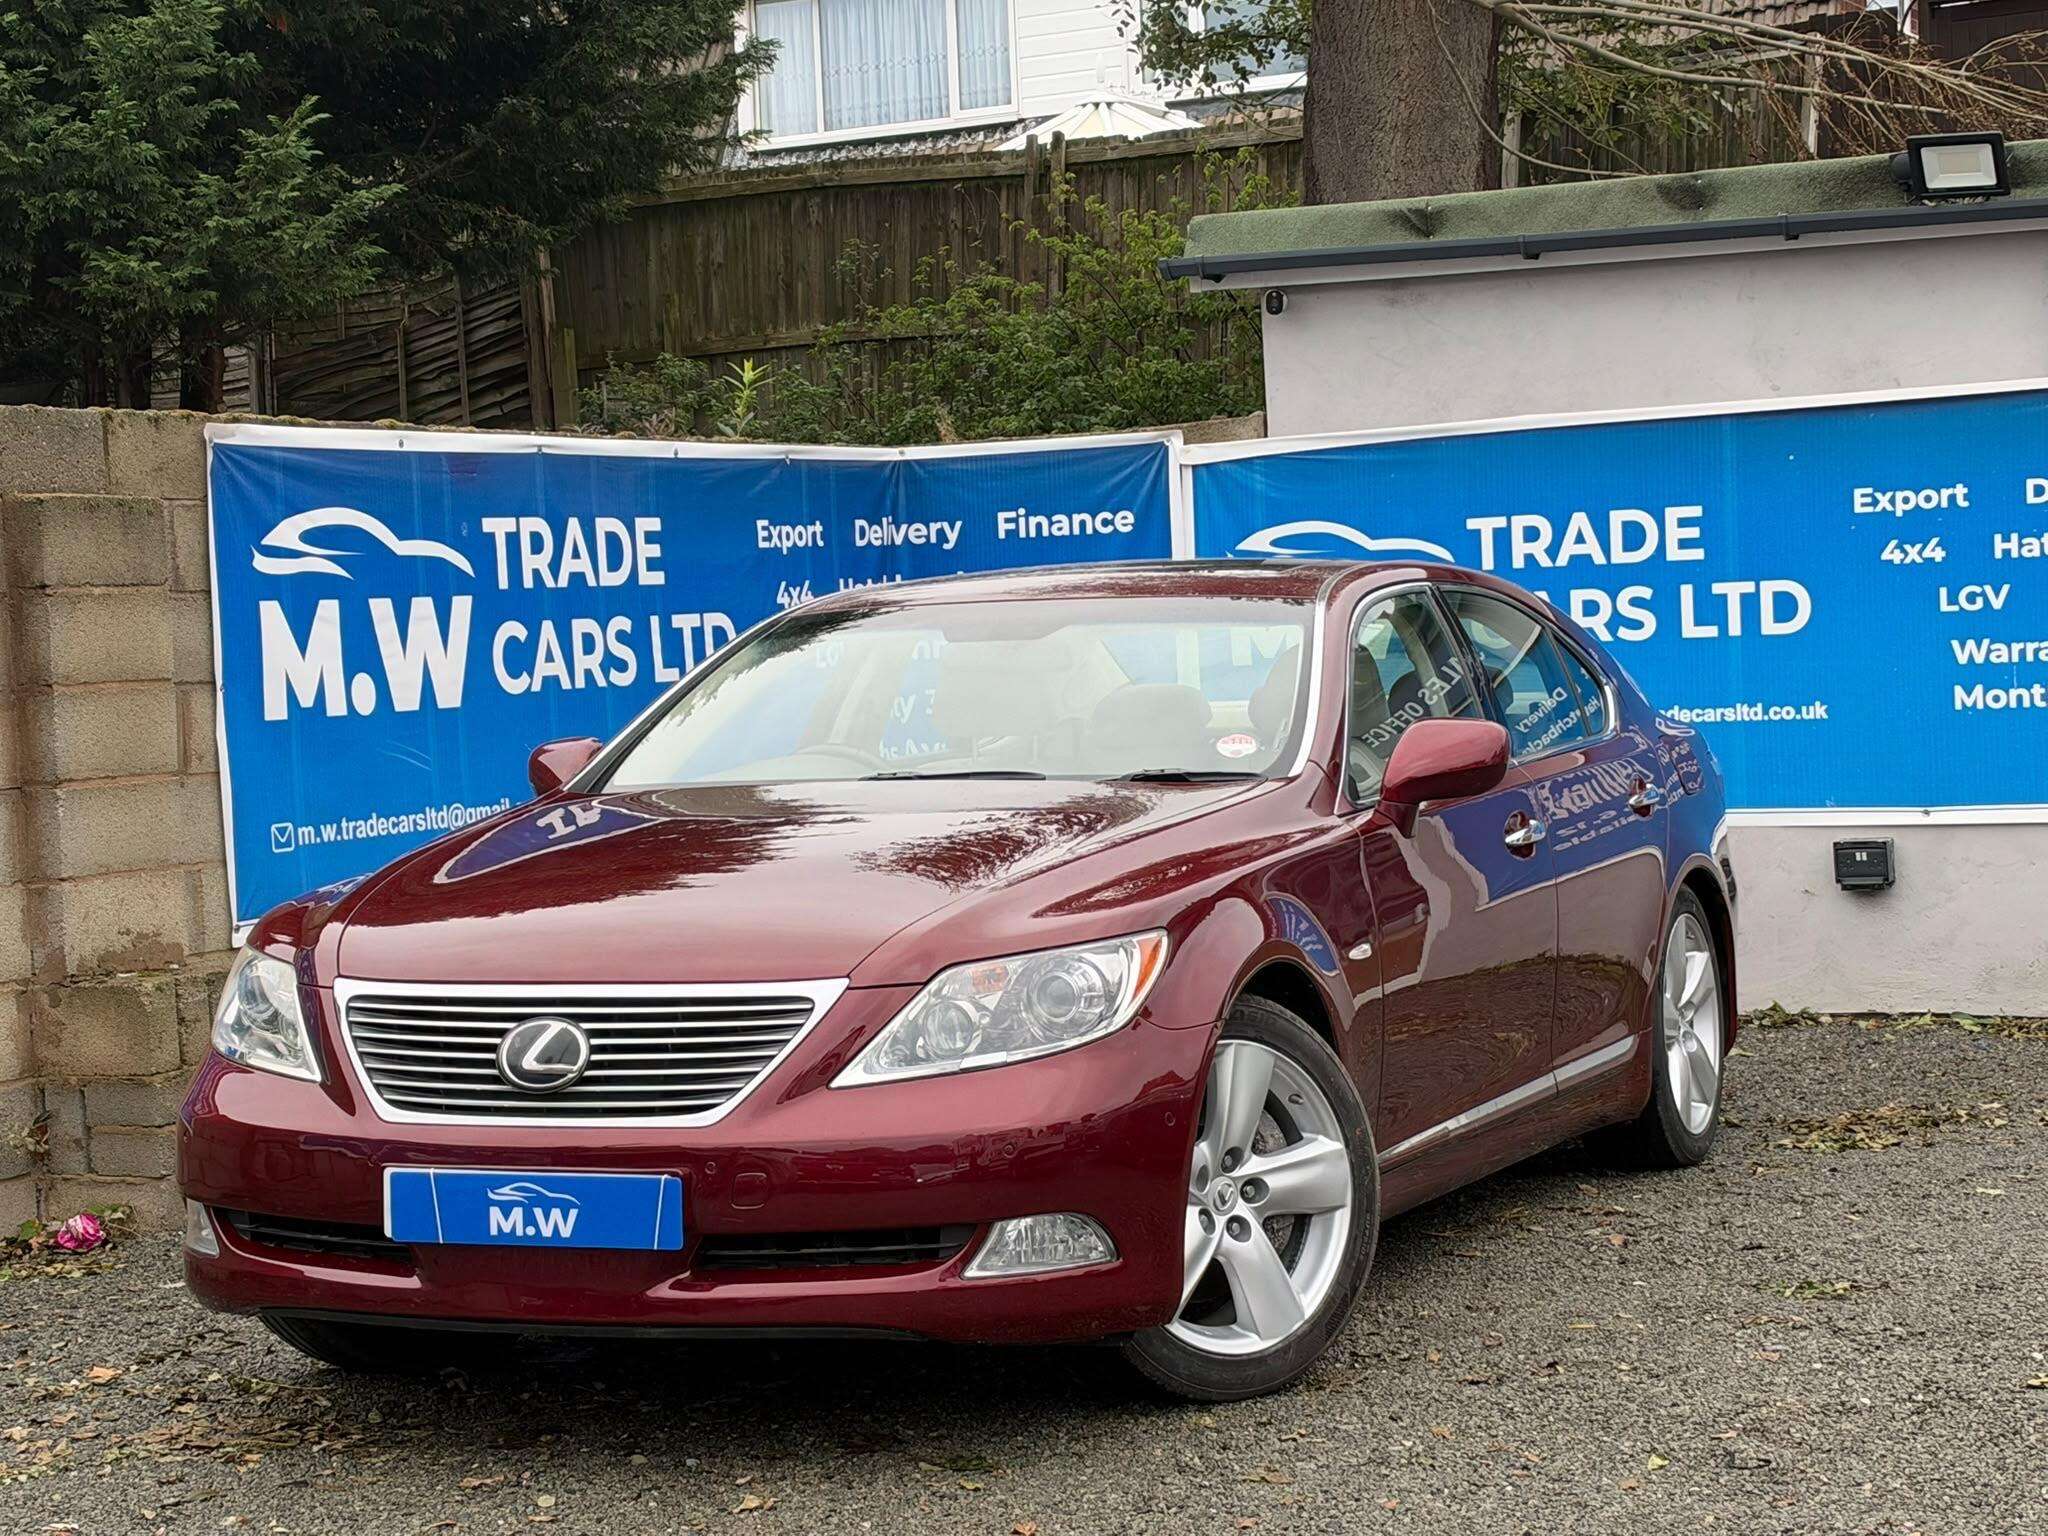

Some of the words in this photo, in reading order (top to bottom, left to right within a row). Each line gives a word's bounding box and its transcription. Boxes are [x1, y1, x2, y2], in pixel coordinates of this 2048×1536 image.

[1853, 483, 1970, 517] Export
[481, 516, 666, 590] TRADE
[756, 518, 824, 554] Export
[853, 515, 962, 550] Delivery
[996, 507, 1135, 540] Finance
[1466, 505, 1705, 571] TRADE
[1880, 537, 1946, 565] 4x4
[1680, 579, 1812, 640] LTD
[1939, 584, 2011, 613] LGV
[259, 594, 474, 722] M.W
[492, 615, 638, 696] CARS
[1659, 700, 1829, 723] decarsltd.co.uk
[489, 1206, 579, 1238] M.W
